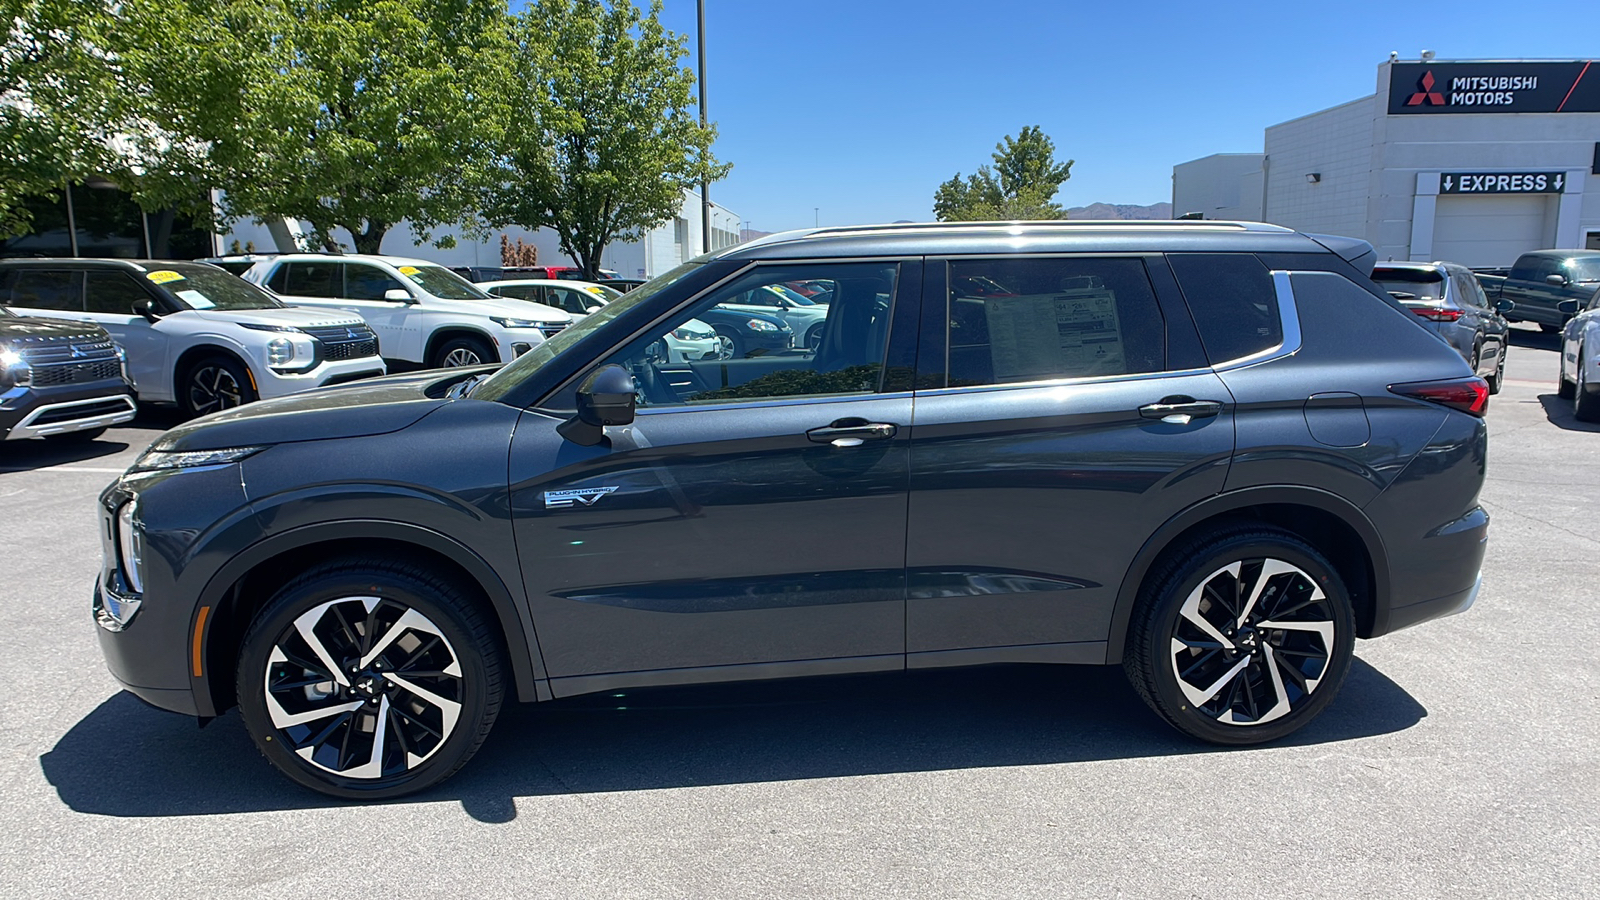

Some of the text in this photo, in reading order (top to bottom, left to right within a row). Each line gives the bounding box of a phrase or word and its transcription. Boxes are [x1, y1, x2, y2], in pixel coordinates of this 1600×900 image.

[1452, 76, 1538, 90] MITSUBISHI
[1451, 92, 1514, 105] MOTORS
[1459, 175, 1547, 191] EXPRESS
[544, 492, 608, 509] EV
